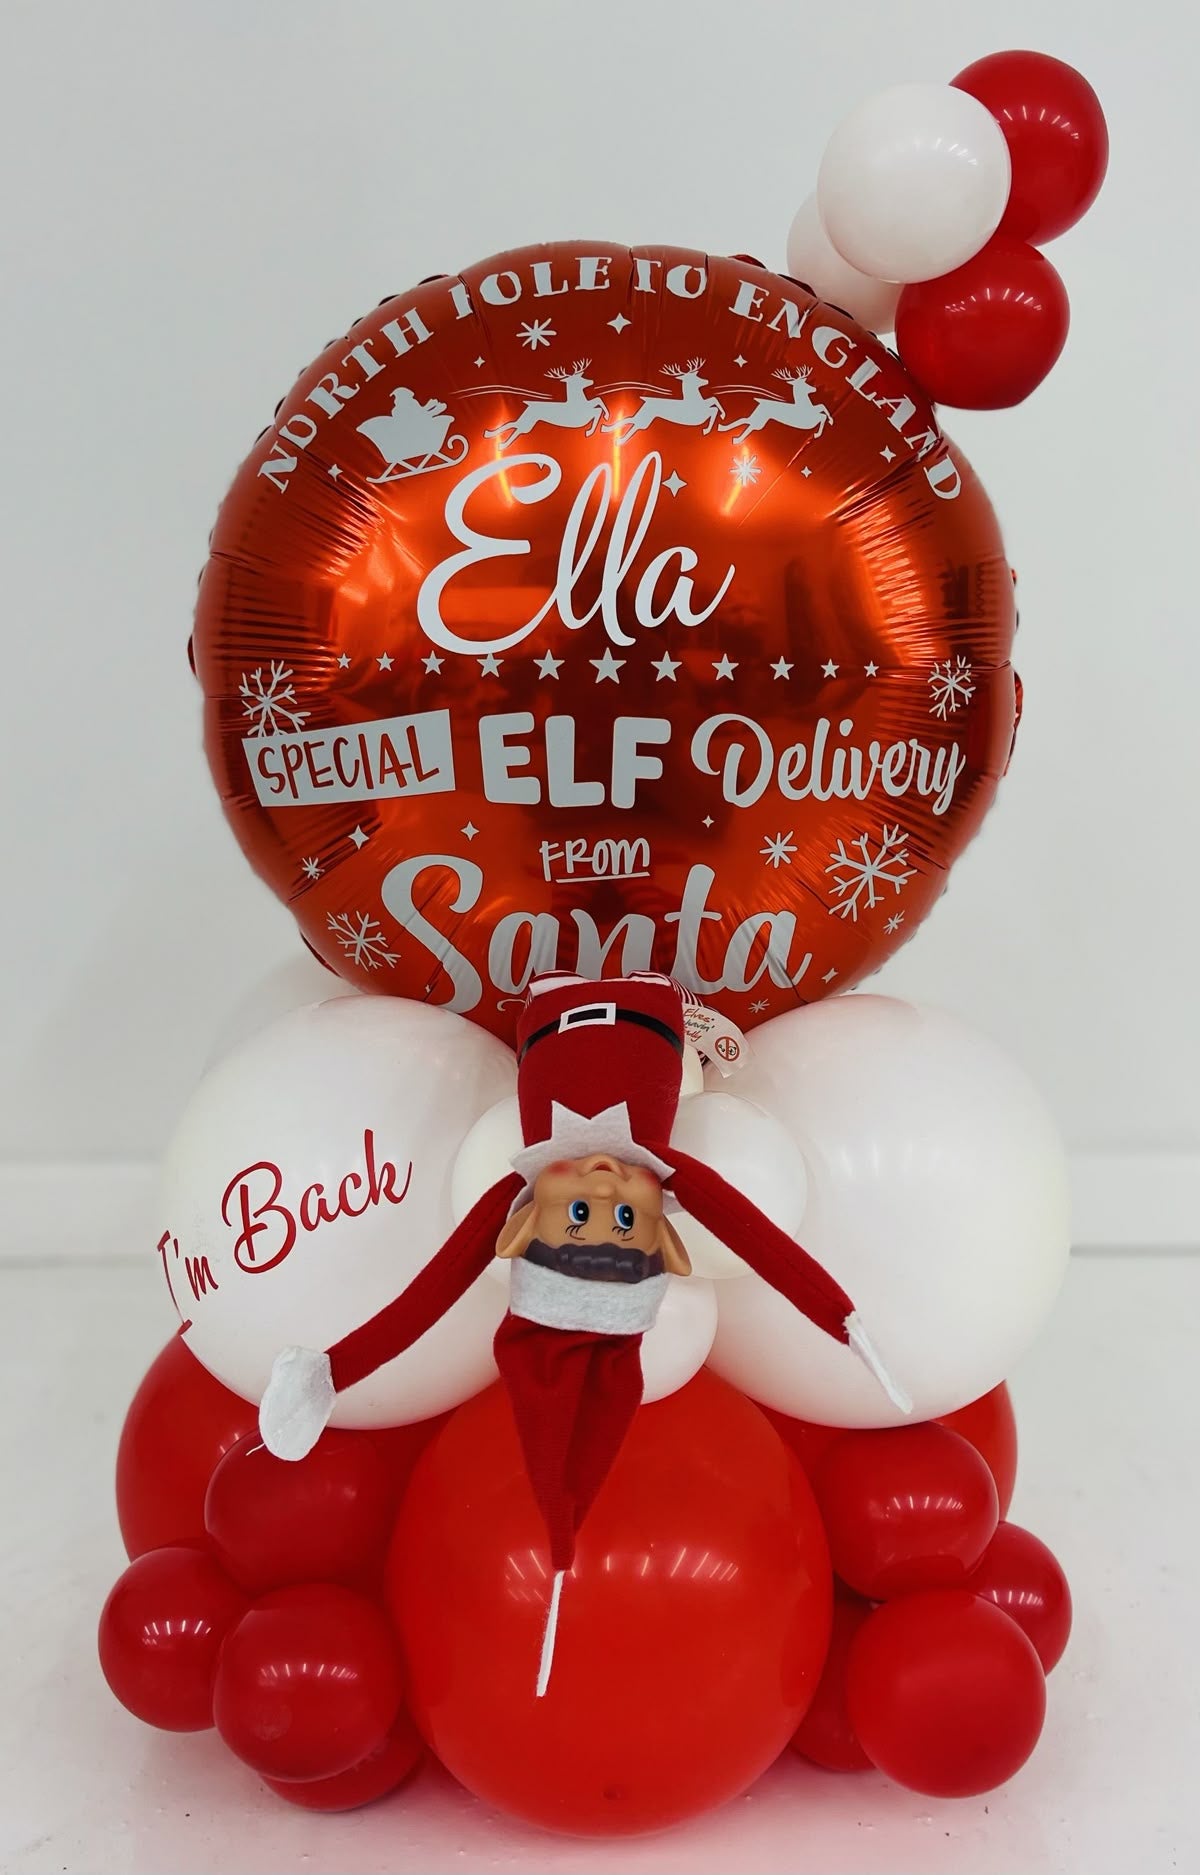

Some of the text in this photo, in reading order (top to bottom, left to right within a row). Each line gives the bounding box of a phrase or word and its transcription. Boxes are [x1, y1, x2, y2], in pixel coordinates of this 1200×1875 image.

[257, 307, 434, 494] NORTH
[632, 257, 708, 299] TO
[728, 279, 962, 500] ENGLAND
[416, 450, 736, 656] Ella
[257, 712, 966, 816] SPECIAL ELF Delivery
[380, 854, 813, 1013] Santa
[538, 837, 651, 882] FROM
[156, 1128, 413, 1335] I'm Back
